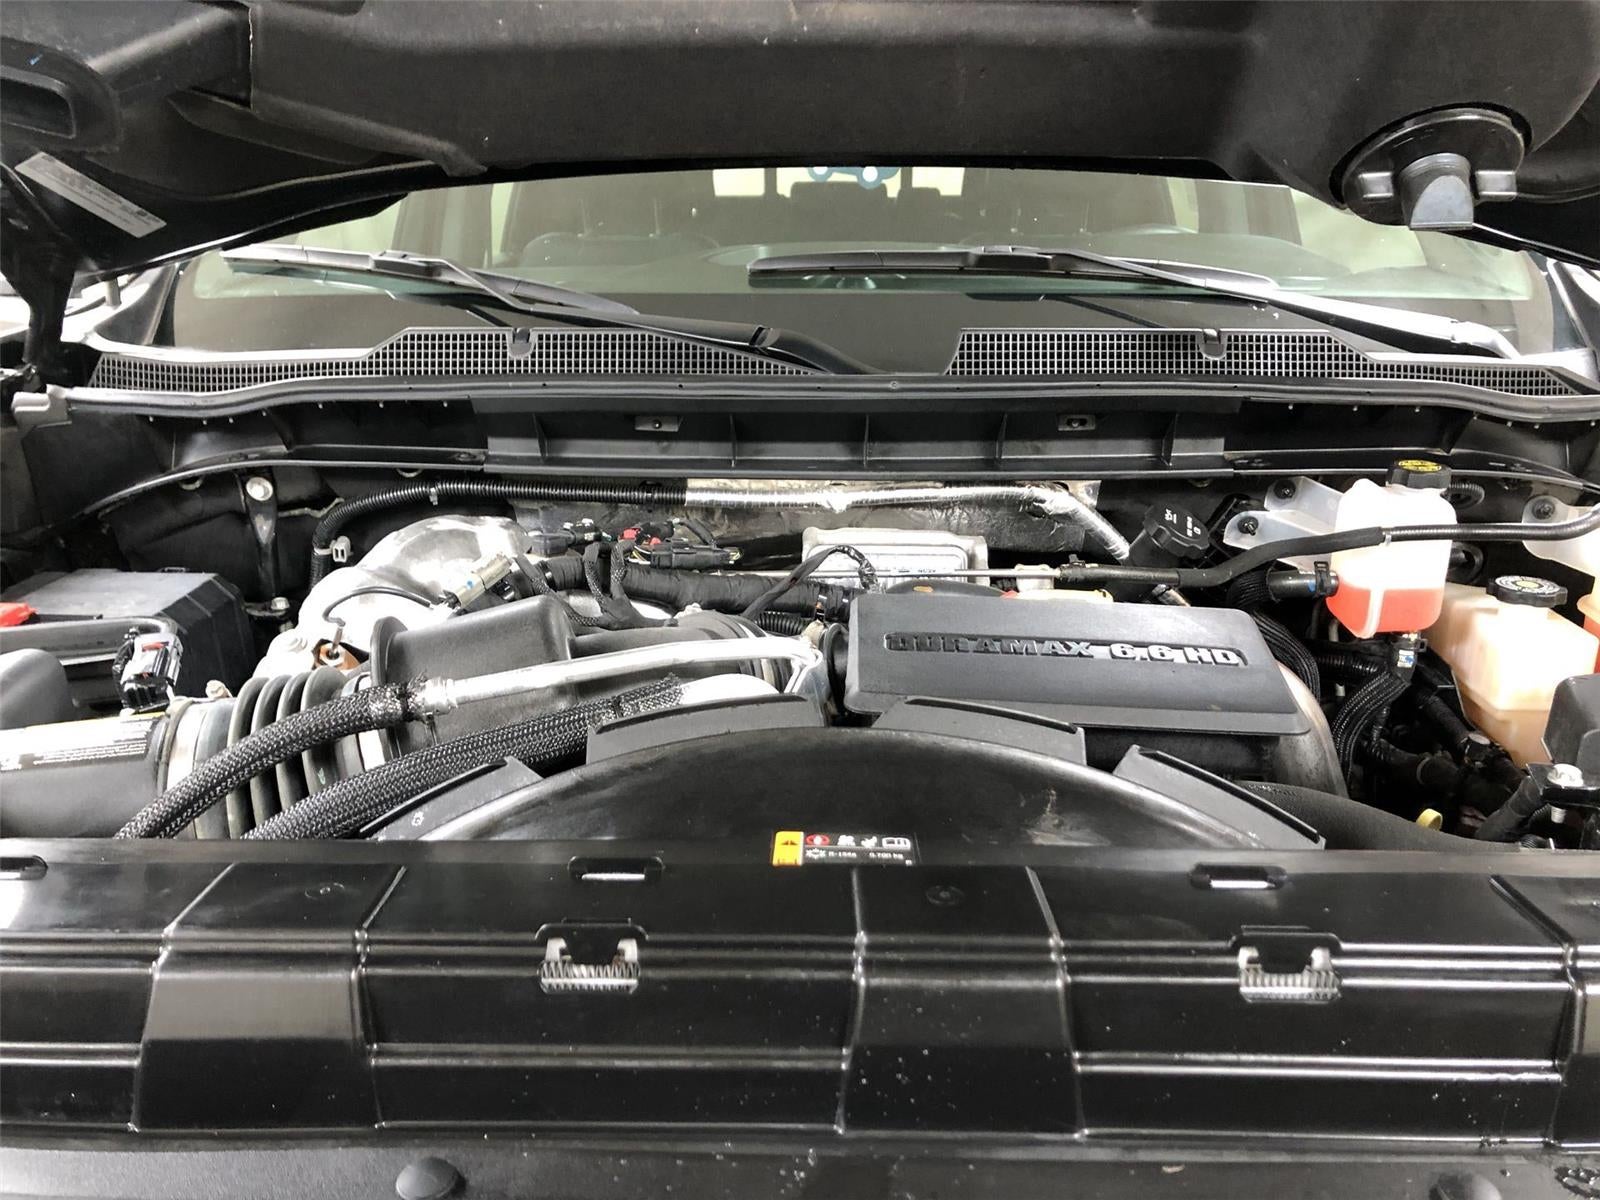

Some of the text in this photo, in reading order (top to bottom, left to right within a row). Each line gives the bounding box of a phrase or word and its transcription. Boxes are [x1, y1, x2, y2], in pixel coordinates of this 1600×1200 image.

[887, 634, 1241, 666] DURAMAX 6.6 HD
